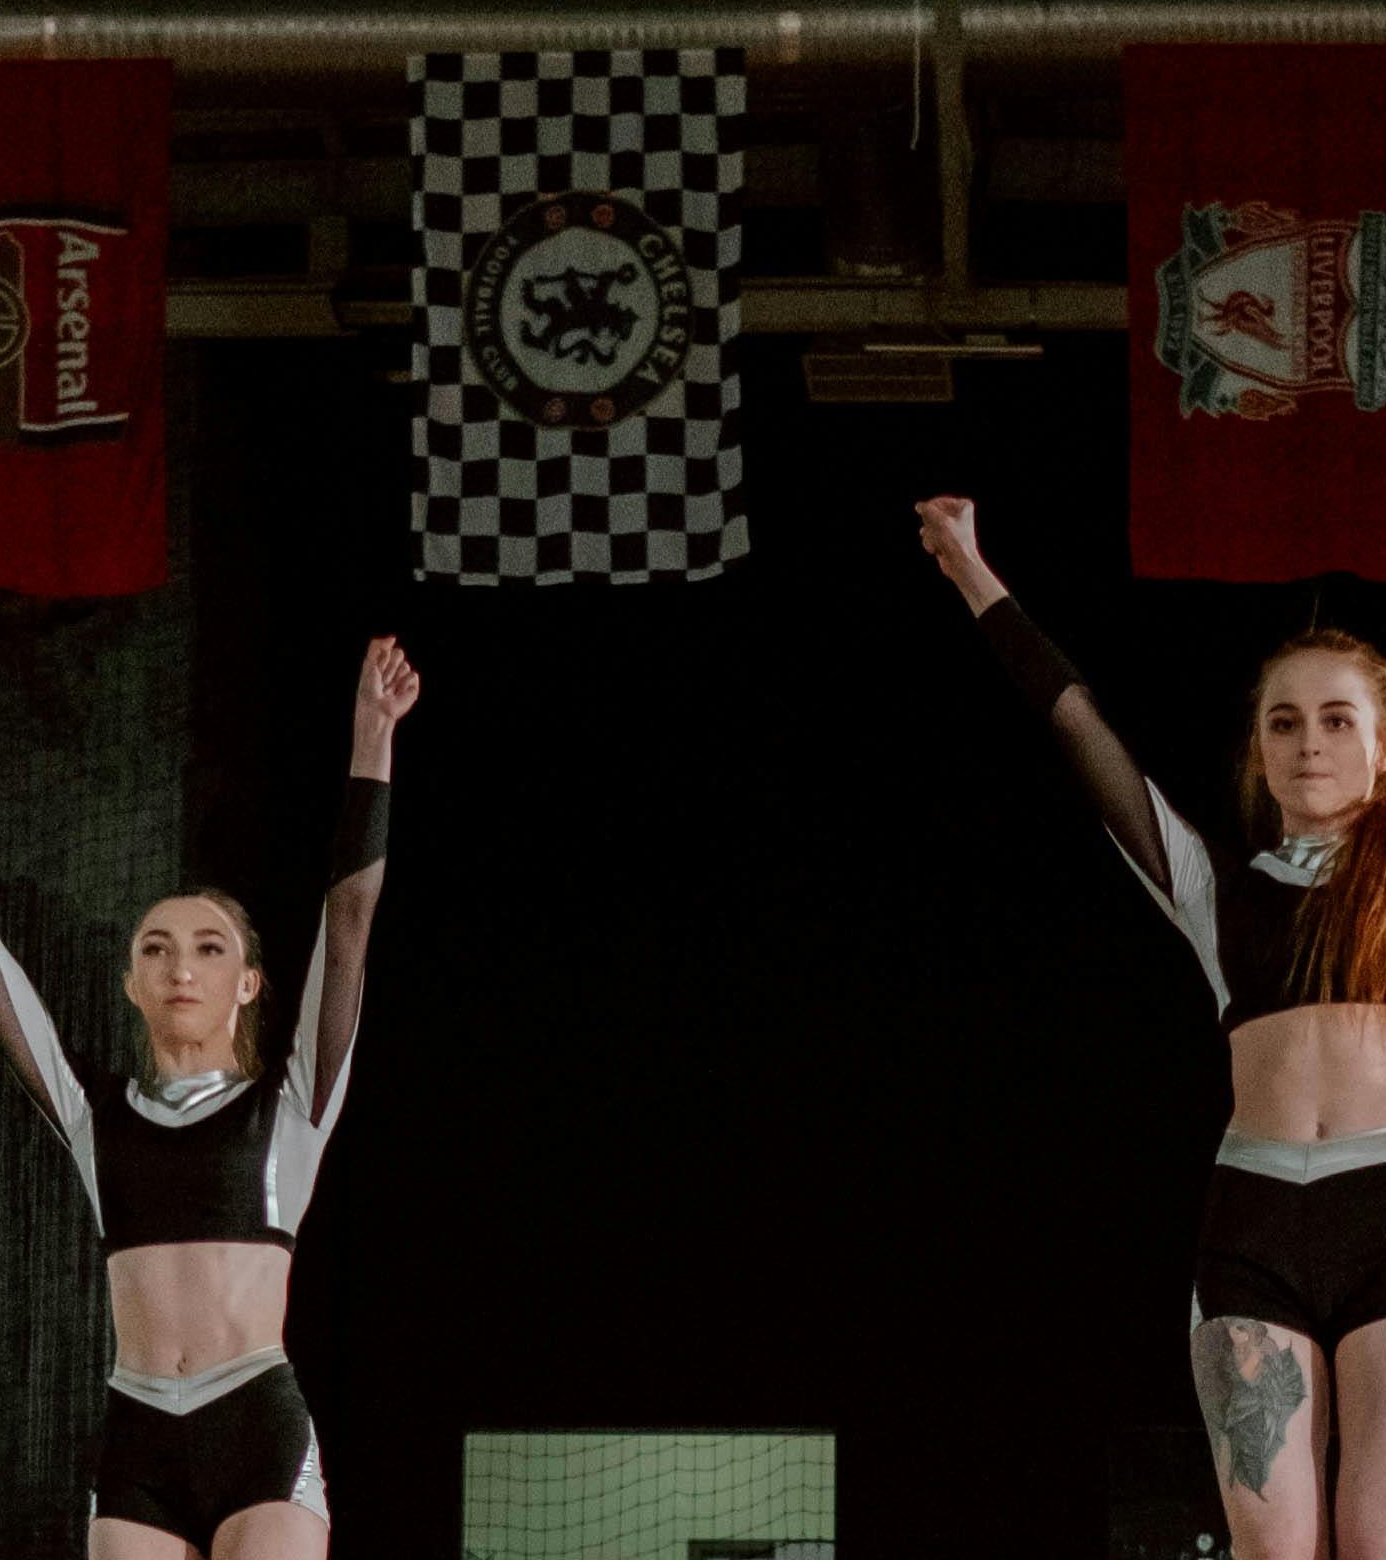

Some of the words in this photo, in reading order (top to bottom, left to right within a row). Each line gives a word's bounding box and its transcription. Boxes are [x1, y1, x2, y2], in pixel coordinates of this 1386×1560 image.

[56, 231, 101, 416] Arsenal
[474, 236, 519, 334] FOOTBALL
[635, 232, 689, 384] CHELSEA
[1310, 235, 1336, 370] LIVERPOOL
[481, 343, 519, 392] CLUB
